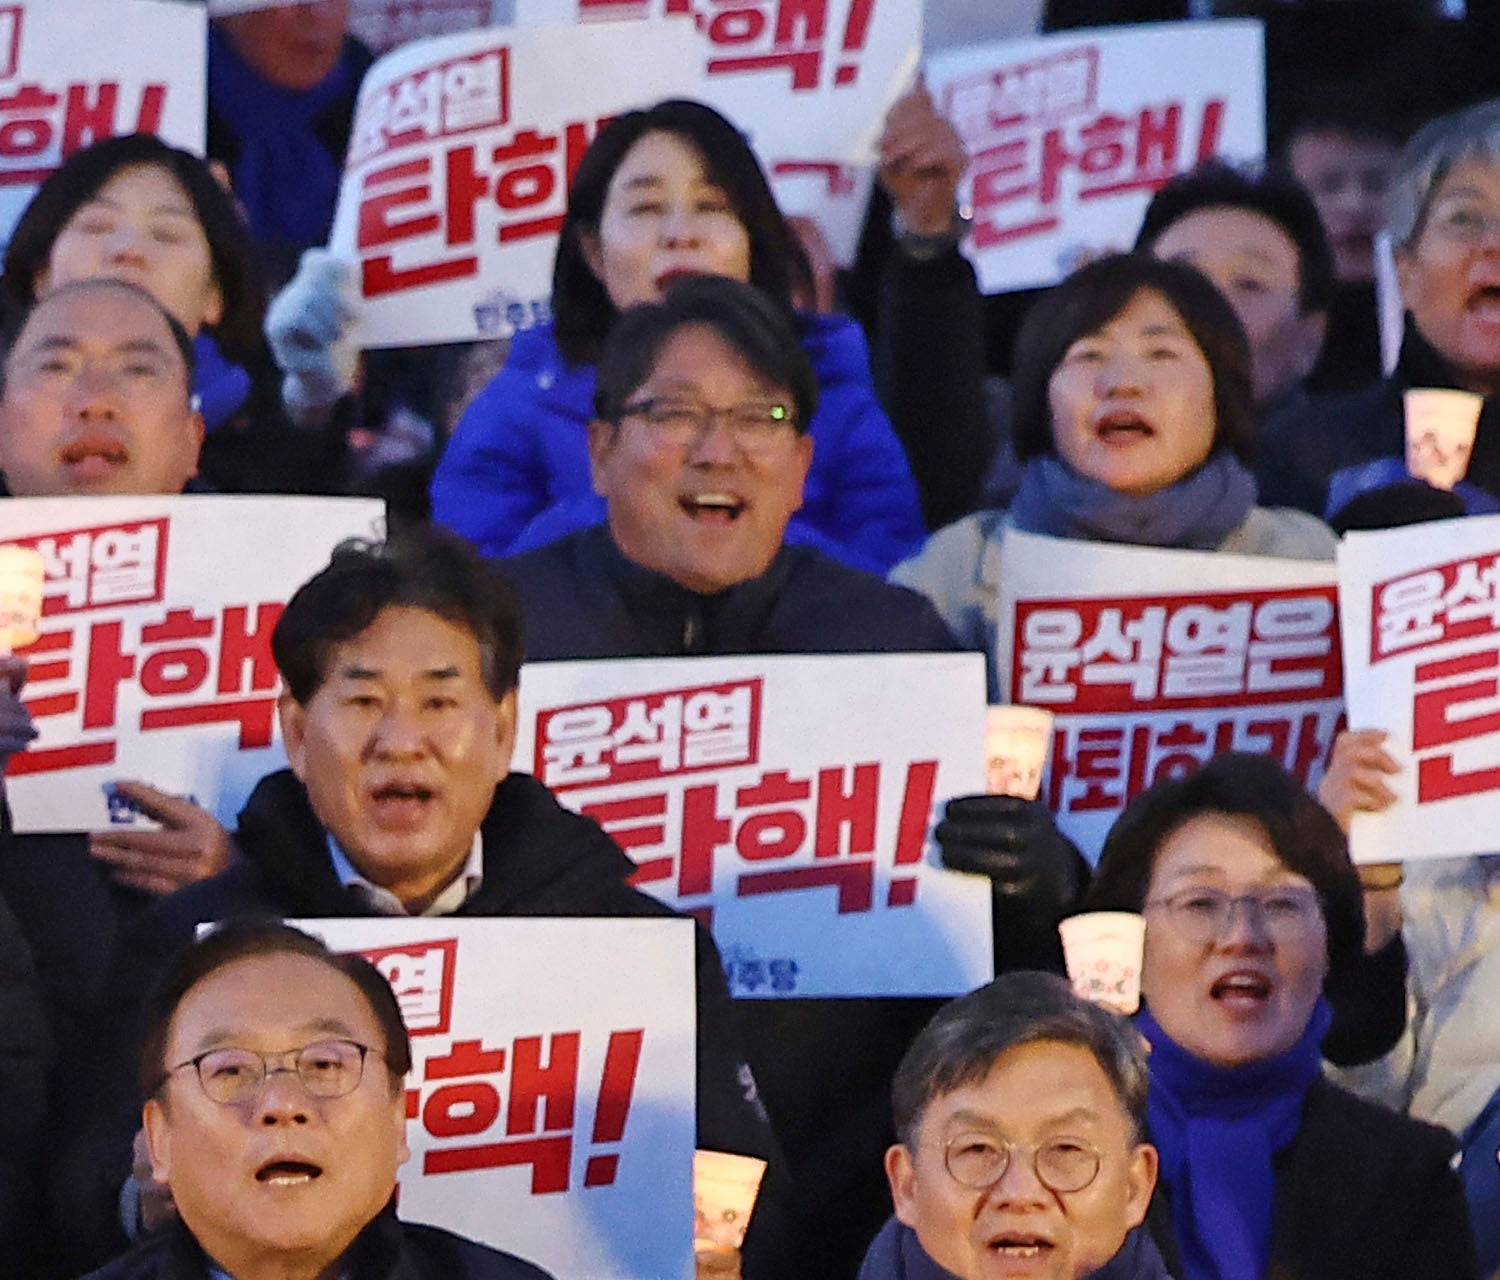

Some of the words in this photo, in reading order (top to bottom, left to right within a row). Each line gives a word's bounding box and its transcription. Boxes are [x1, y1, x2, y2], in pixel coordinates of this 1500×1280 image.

[972, 102, 1226, 248] 탄핵!
[1021, 598, 1334, 705] 윤석열은
[545, 688, 753, 788] 윤석열
[591, 762, 939, 931] 탄핵!
[403, 1030, 644, 1195] 핵!
